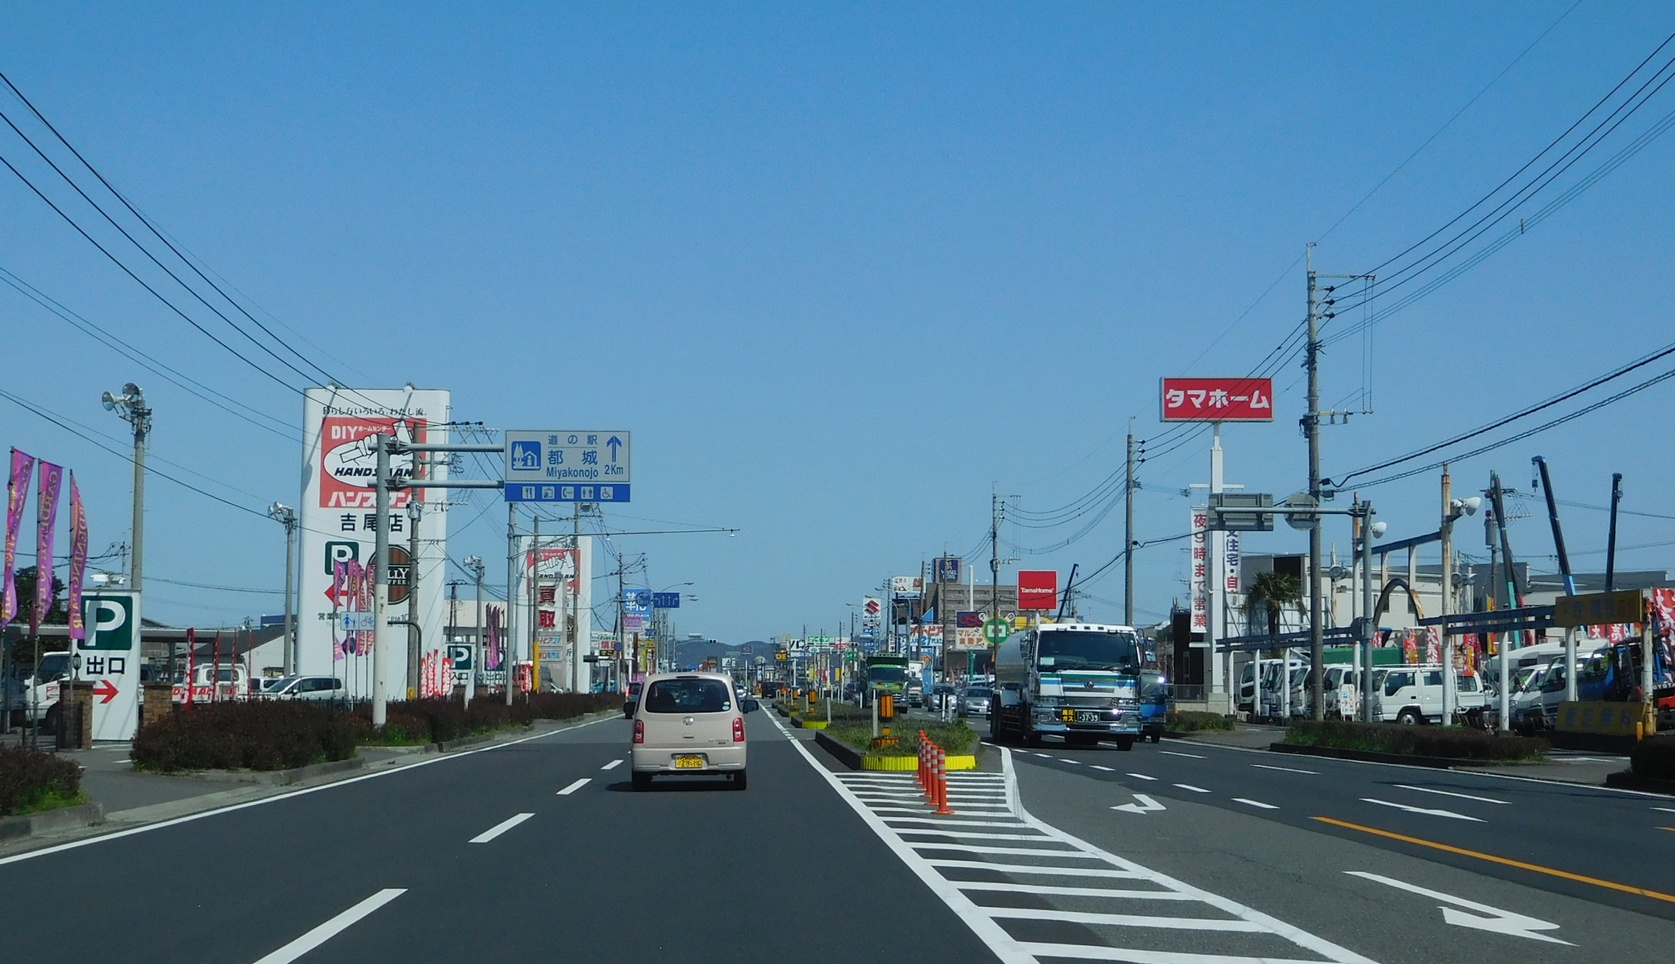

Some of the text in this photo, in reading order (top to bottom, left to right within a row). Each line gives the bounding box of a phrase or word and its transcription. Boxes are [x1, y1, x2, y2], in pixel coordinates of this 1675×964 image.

[1166, 389, 1270, 408] タマホーム
[331, 425, 357, 439] DIY
[548, 435, 598, 445] 道の駅
[547, 450, 598, 465] 都城
[546, 467, 599, 479] Miyakonojo
[340, 513, 404, 532] 吉尾店
[84, 600, 126, 646] P
[86, 656, 125, 675] 出口
[450, 672, 468, 680] 入口
